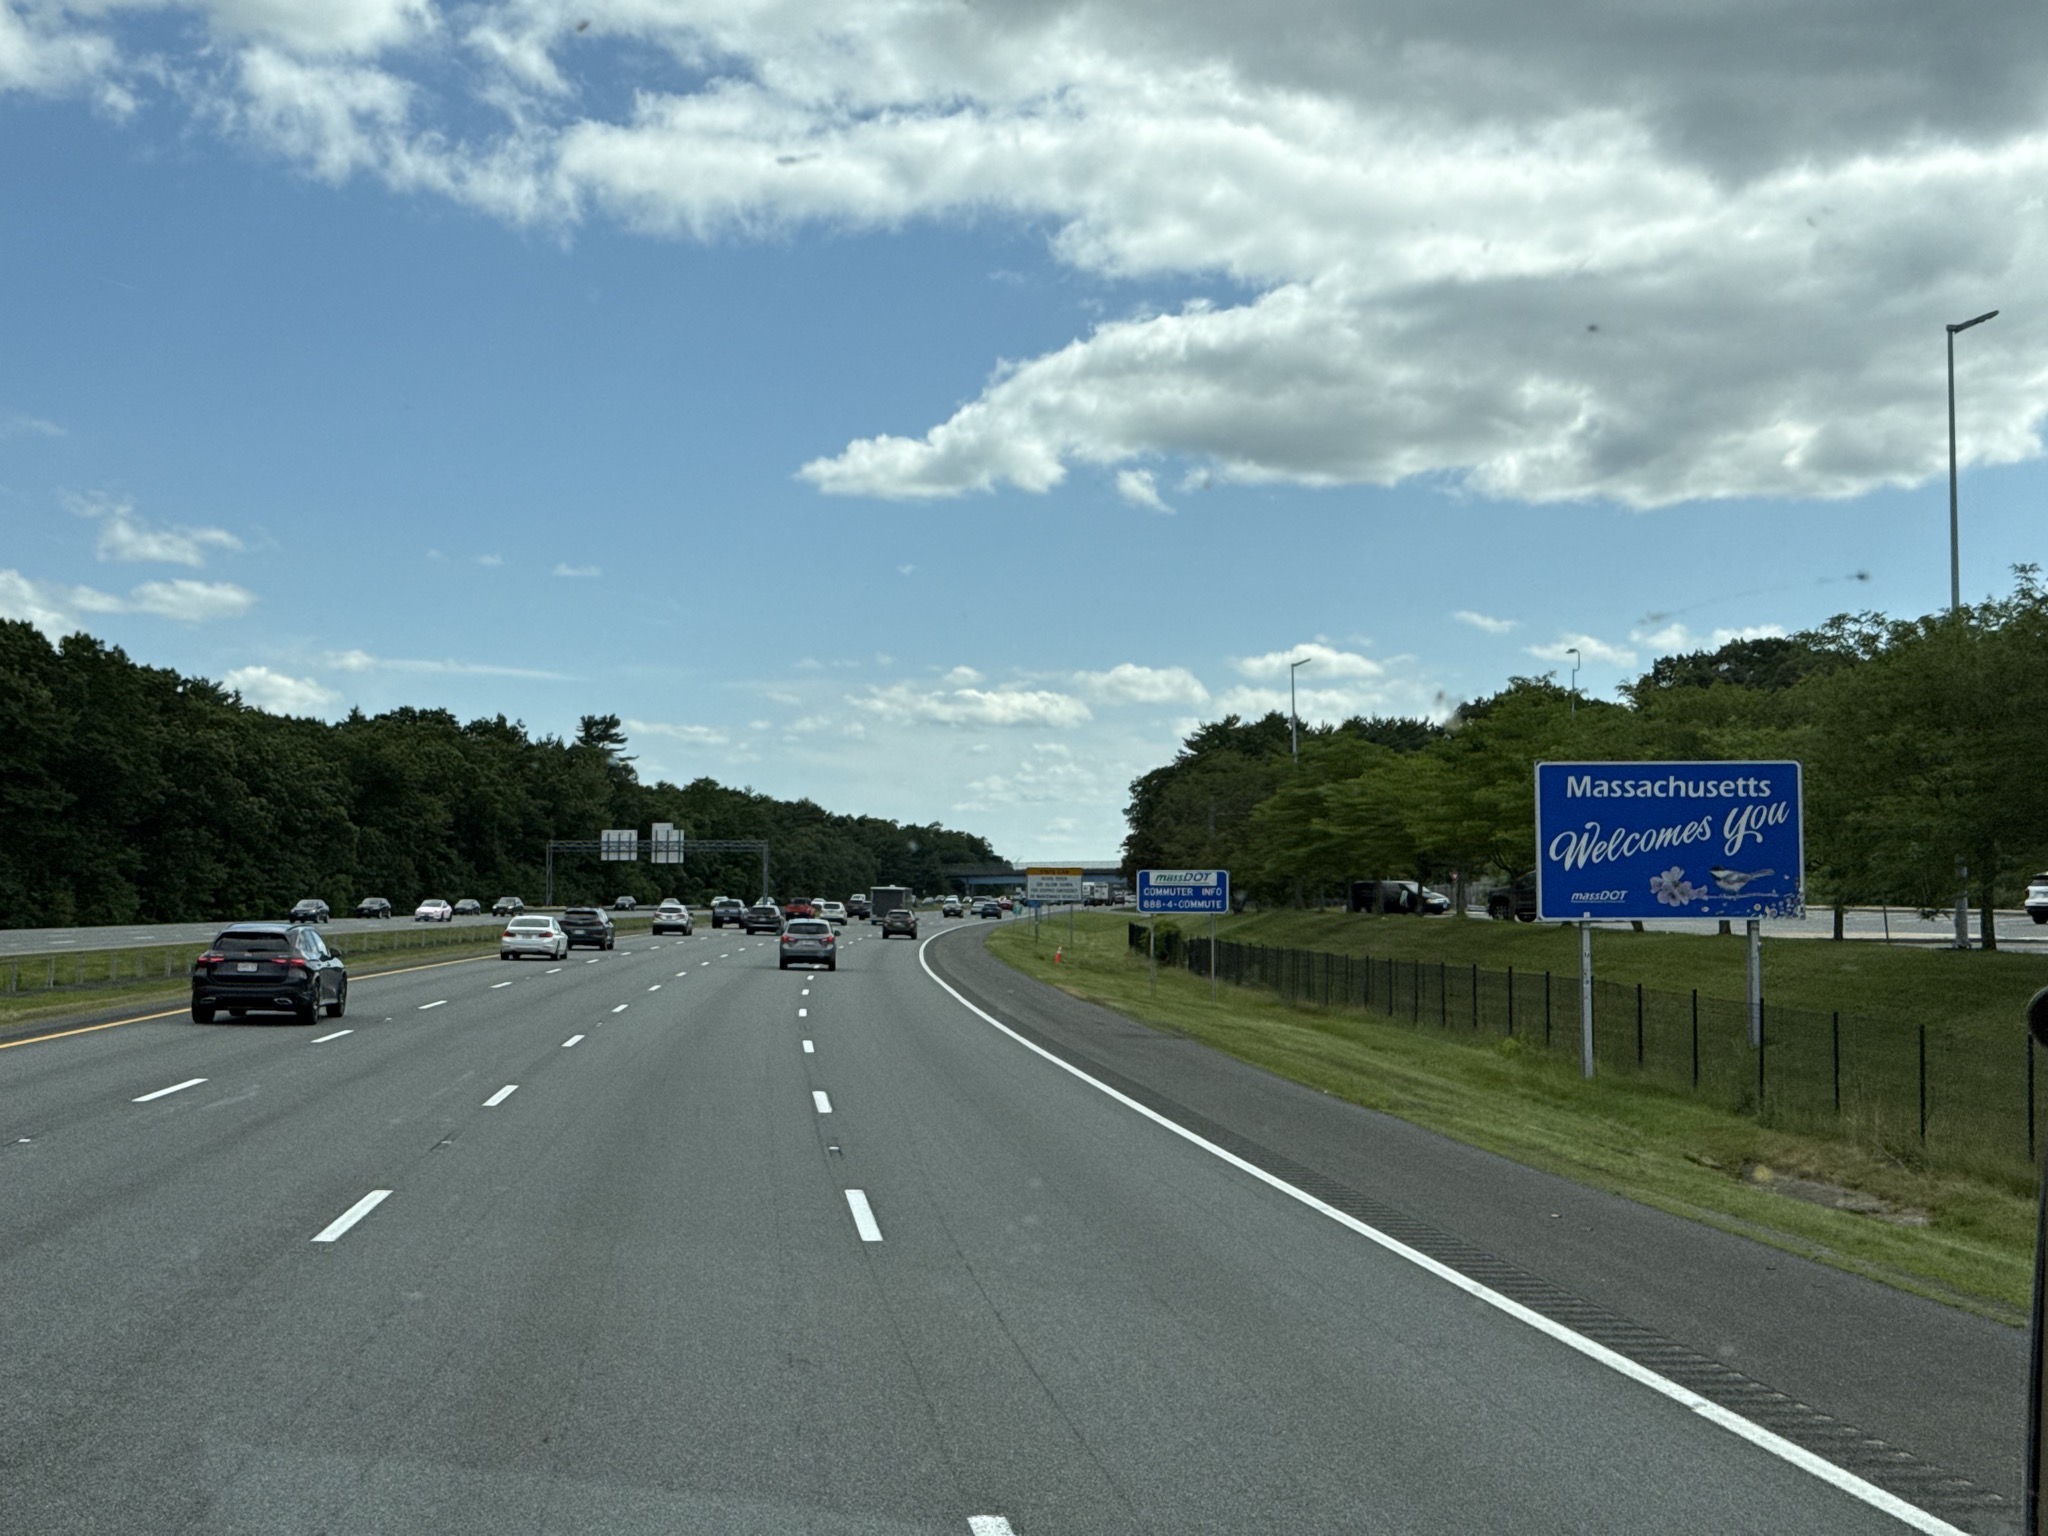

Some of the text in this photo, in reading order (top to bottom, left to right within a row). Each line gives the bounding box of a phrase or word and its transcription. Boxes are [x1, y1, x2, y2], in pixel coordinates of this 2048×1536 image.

[1566, 775, 1772, 799] Massachusetts
[1549, 801, 1790, 872] Welcomes You
[1155, 872, 1212, 882] massDOT
[1143, 887, 1223, 896] COMMUTER INFO
[1571, 890, 1629, 901] massDOT
